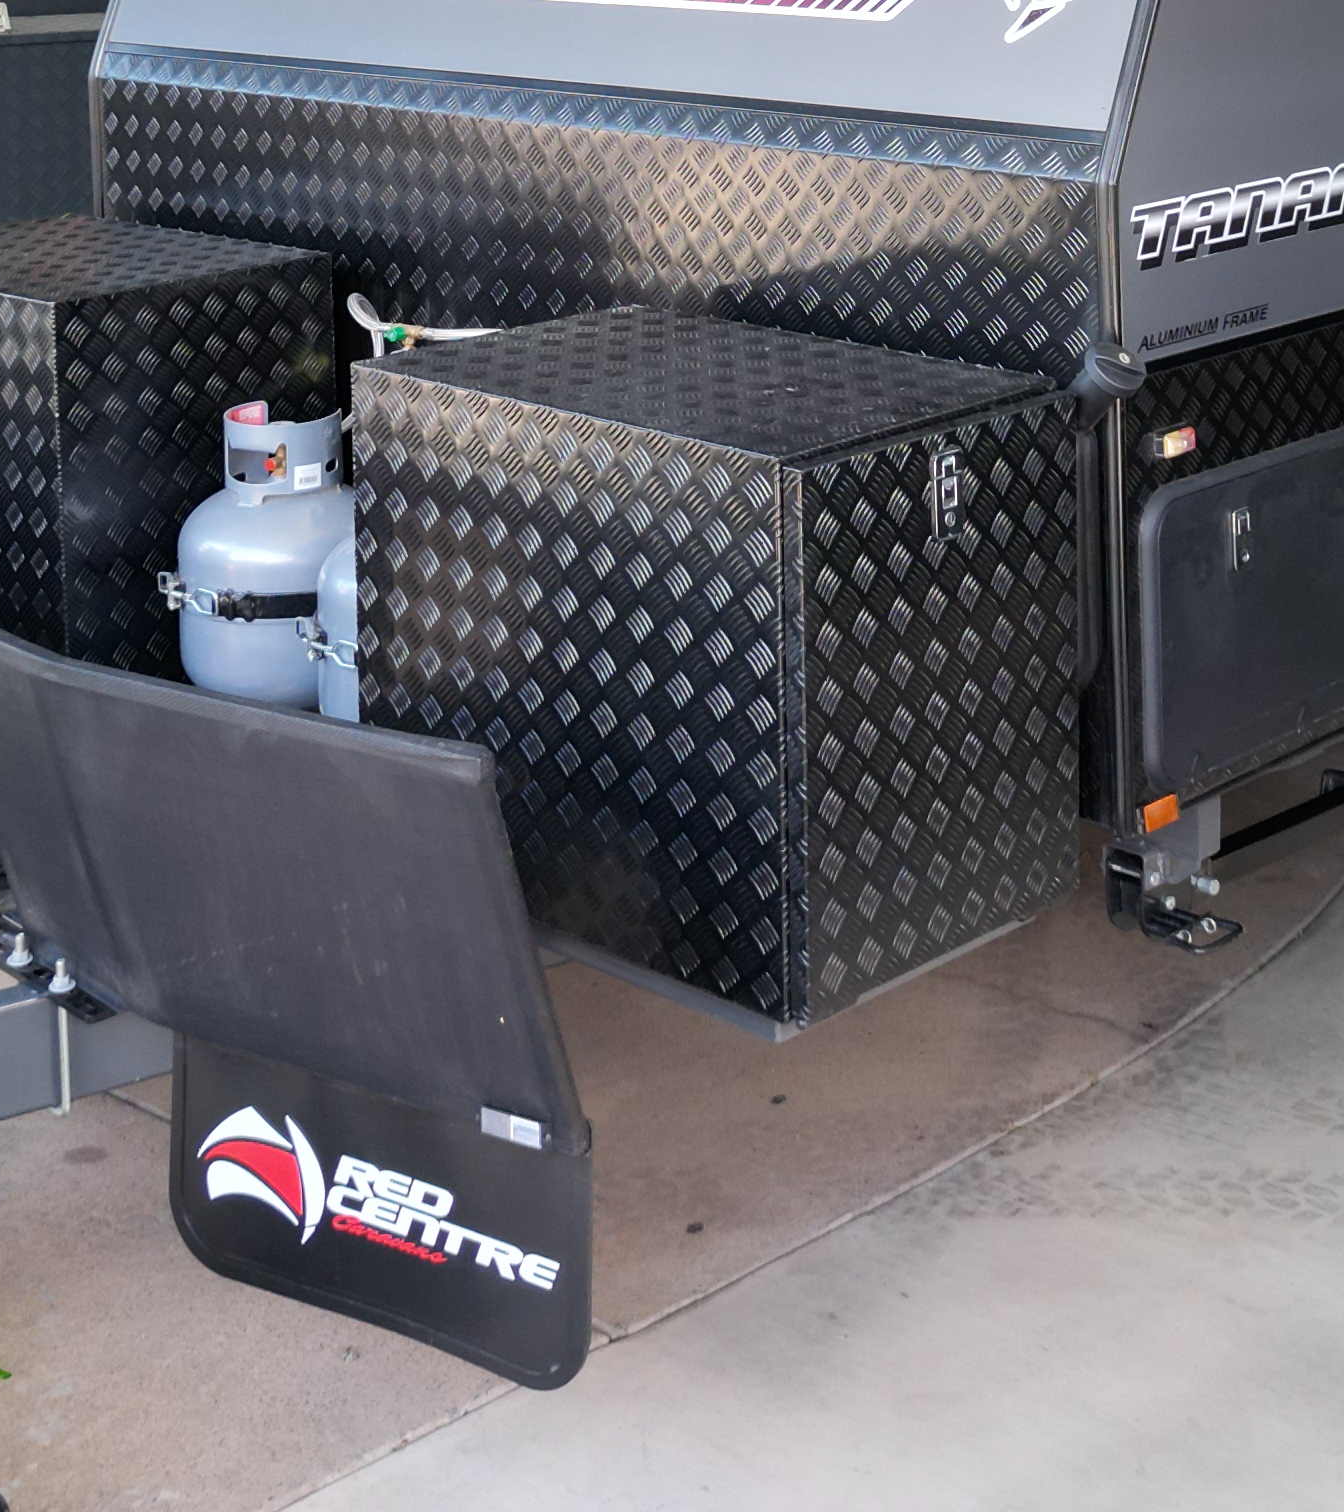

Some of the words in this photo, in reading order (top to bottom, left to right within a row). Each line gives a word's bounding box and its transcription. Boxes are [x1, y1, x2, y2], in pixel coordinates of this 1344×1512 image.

[1137, 317, 1219, 353] ALUMINIUM
[1223, 303, 1269, 330] FRAME
[333, 1154, 454, 1218] RED
[326, 1185, 560, 1290] CENTRE
[331, 1214, 448, 1265] Caravans
